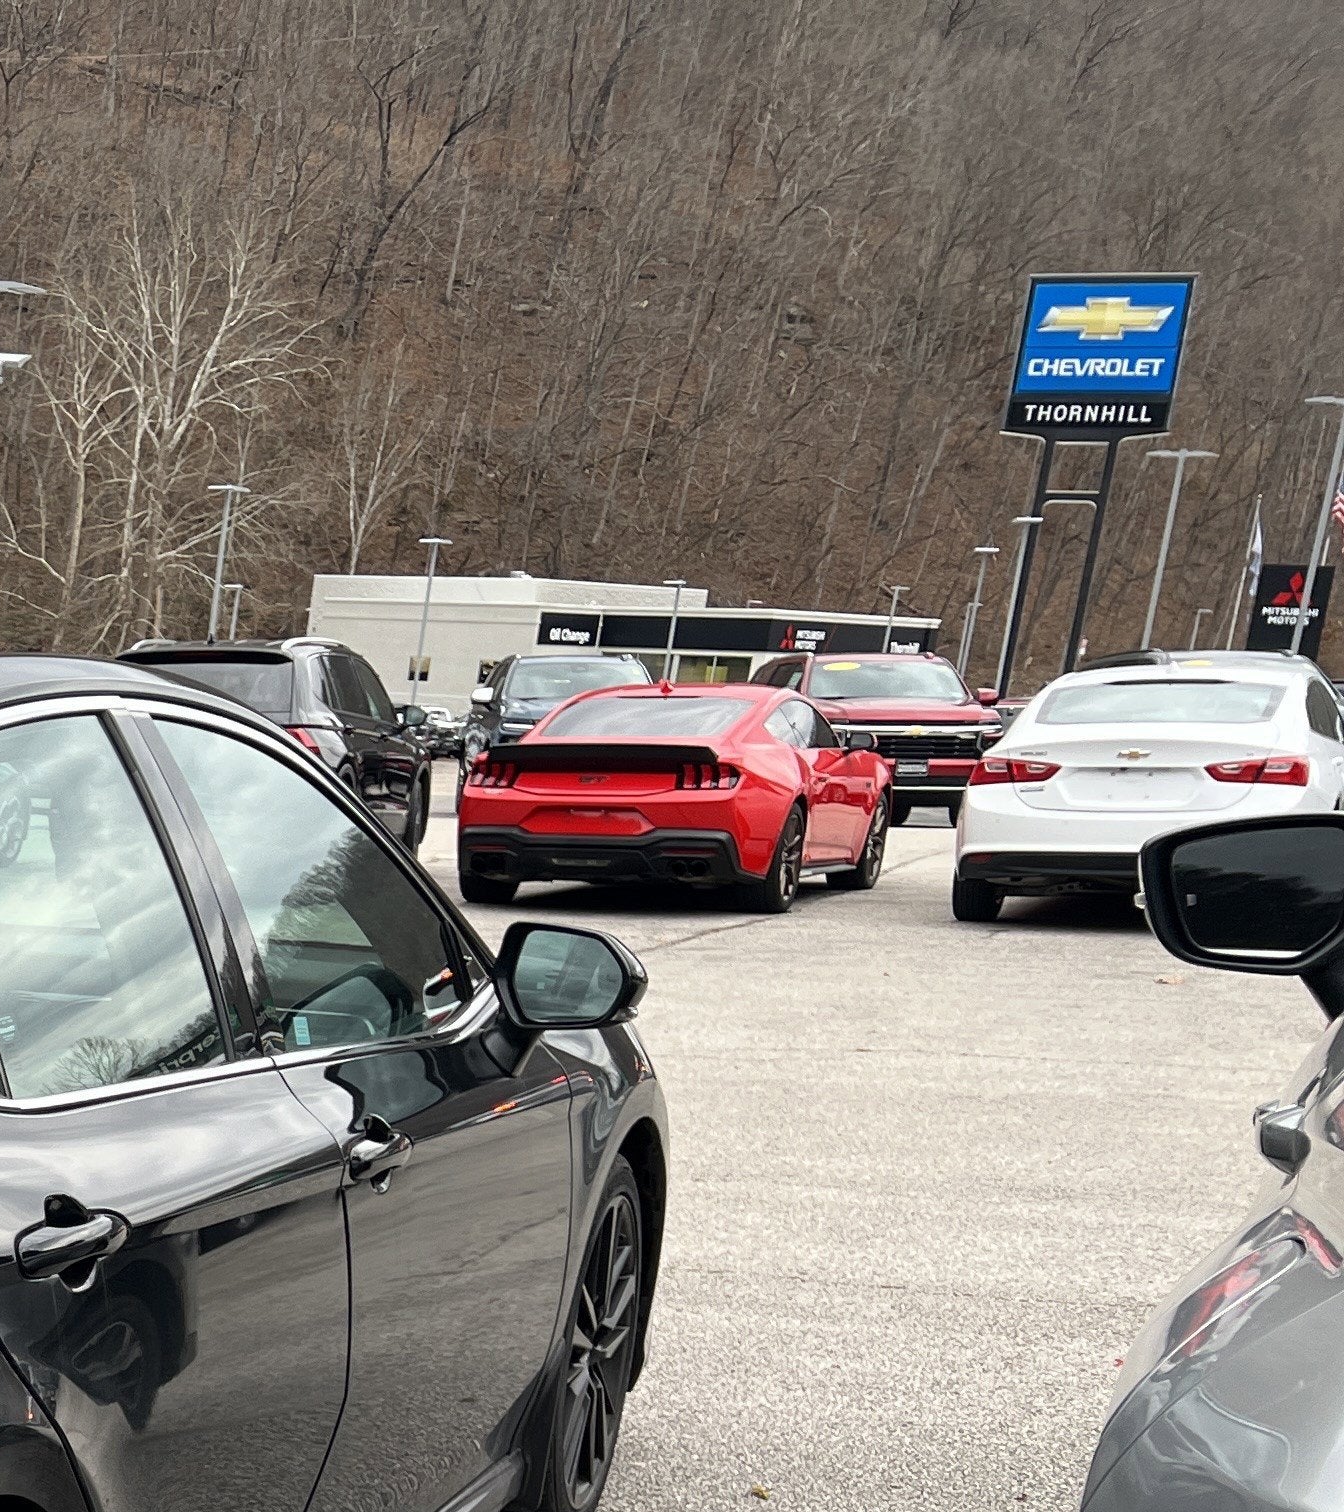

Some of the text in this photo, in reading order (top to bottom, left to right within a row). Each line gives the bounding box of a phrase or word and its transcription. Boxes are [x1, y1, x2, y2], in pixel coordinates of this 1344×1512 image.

[1027, 358, 1166, 377] CHEVROLET
[1024, 404, 1152, 423] THORNHILL
[1262, 606, 1320, 617] MITSUBHI
[1267, 615, 1309, 626] MOTOS
[549, 627, 590, 645] Oil Change
